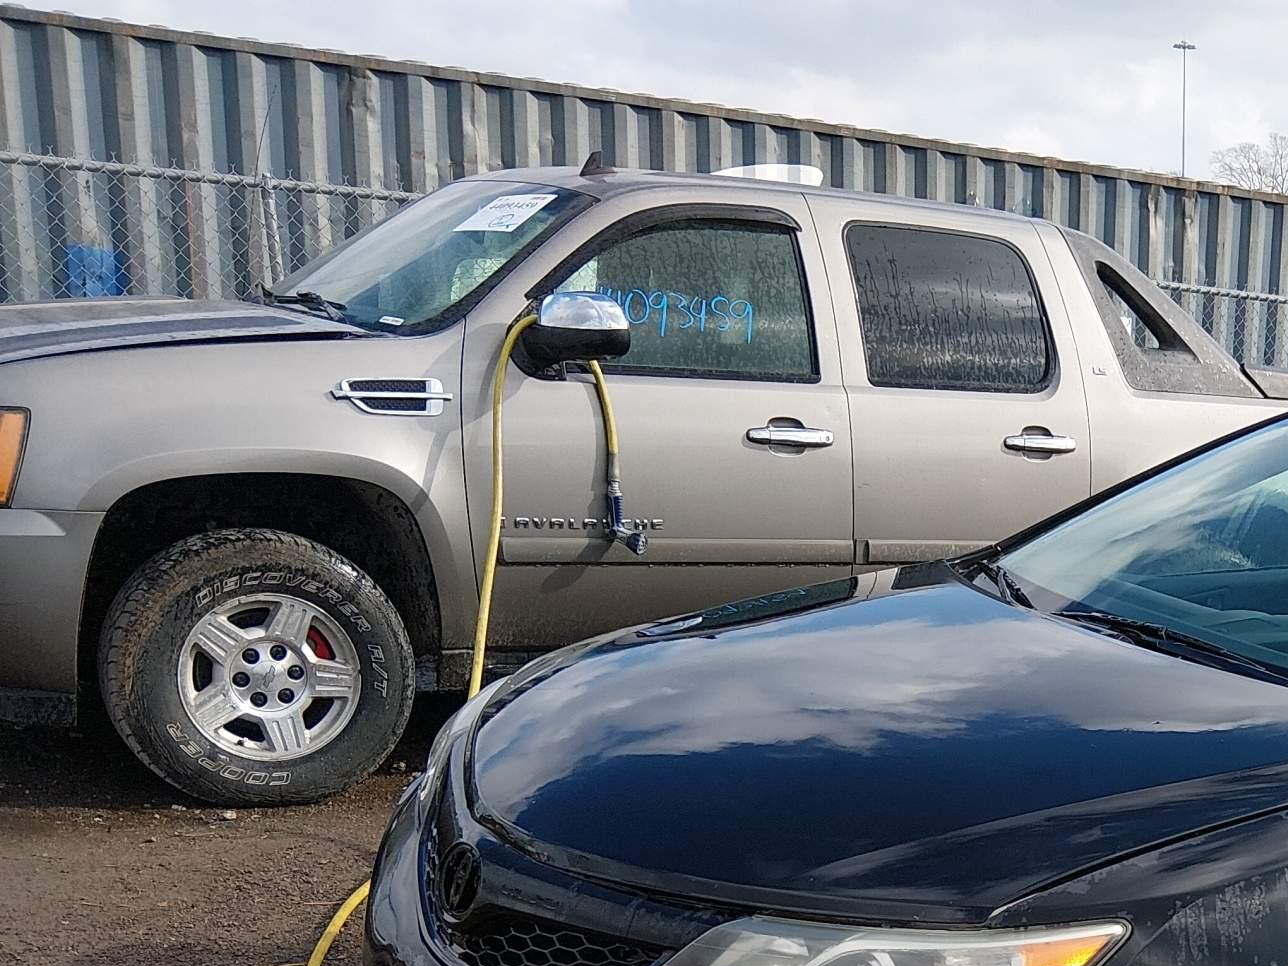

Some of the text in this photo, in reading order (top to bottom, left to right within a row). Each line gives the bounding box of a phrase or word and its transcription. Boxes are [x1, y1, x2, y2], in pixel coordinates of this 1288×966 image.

[598, 286, 753, 345] 093459
[195, 571, 389, 698] DISCOVERER A/T
[166, 721, 292, 787] COOPER
